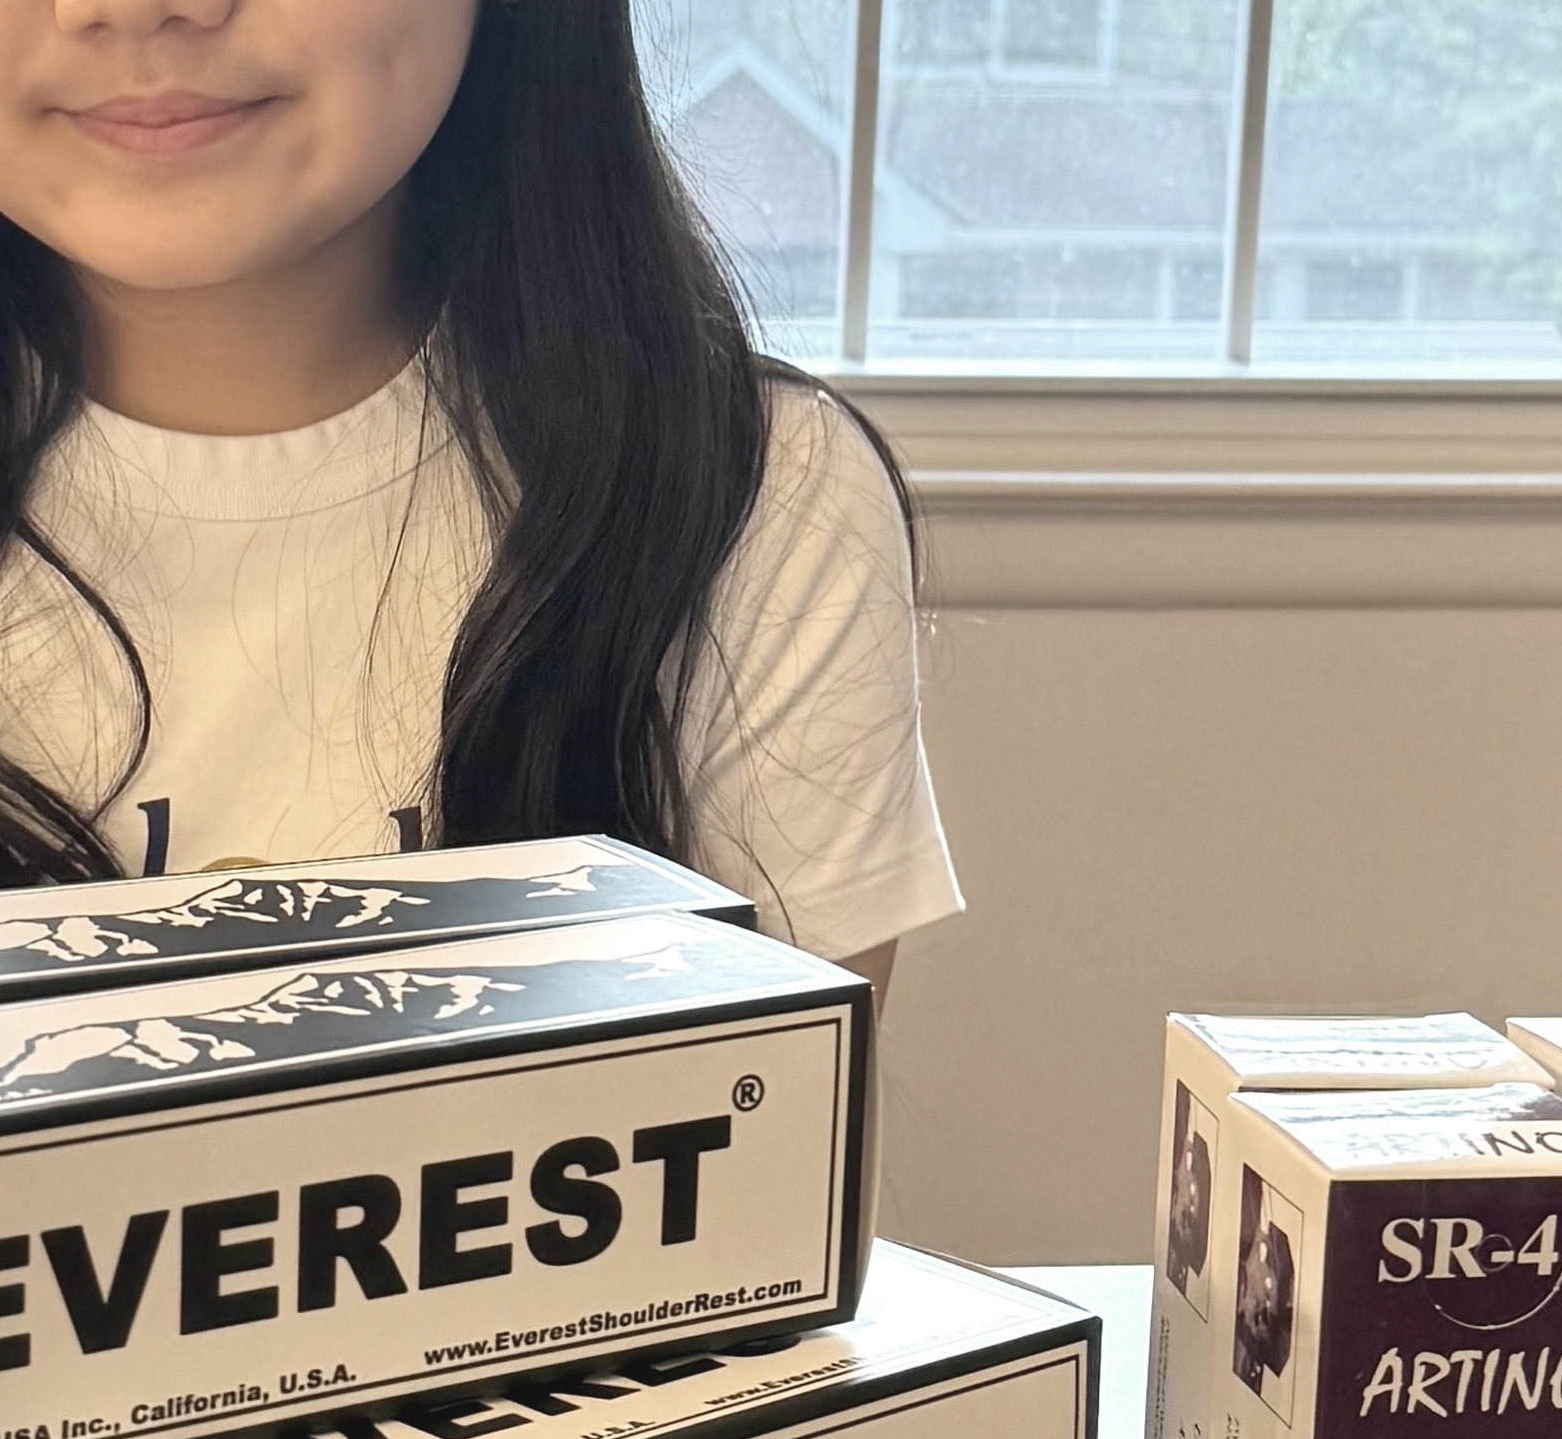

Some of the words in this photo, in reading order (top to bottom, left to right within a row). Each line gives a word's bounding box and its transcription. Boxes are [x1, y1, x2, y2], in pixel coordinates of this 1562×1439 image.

[423, 1276, 802, 1366] www.EverestShoulderRest.com
[129, 1384, 270, 1427] California,
[278, 1364, 358, 1397] U.S.A.
